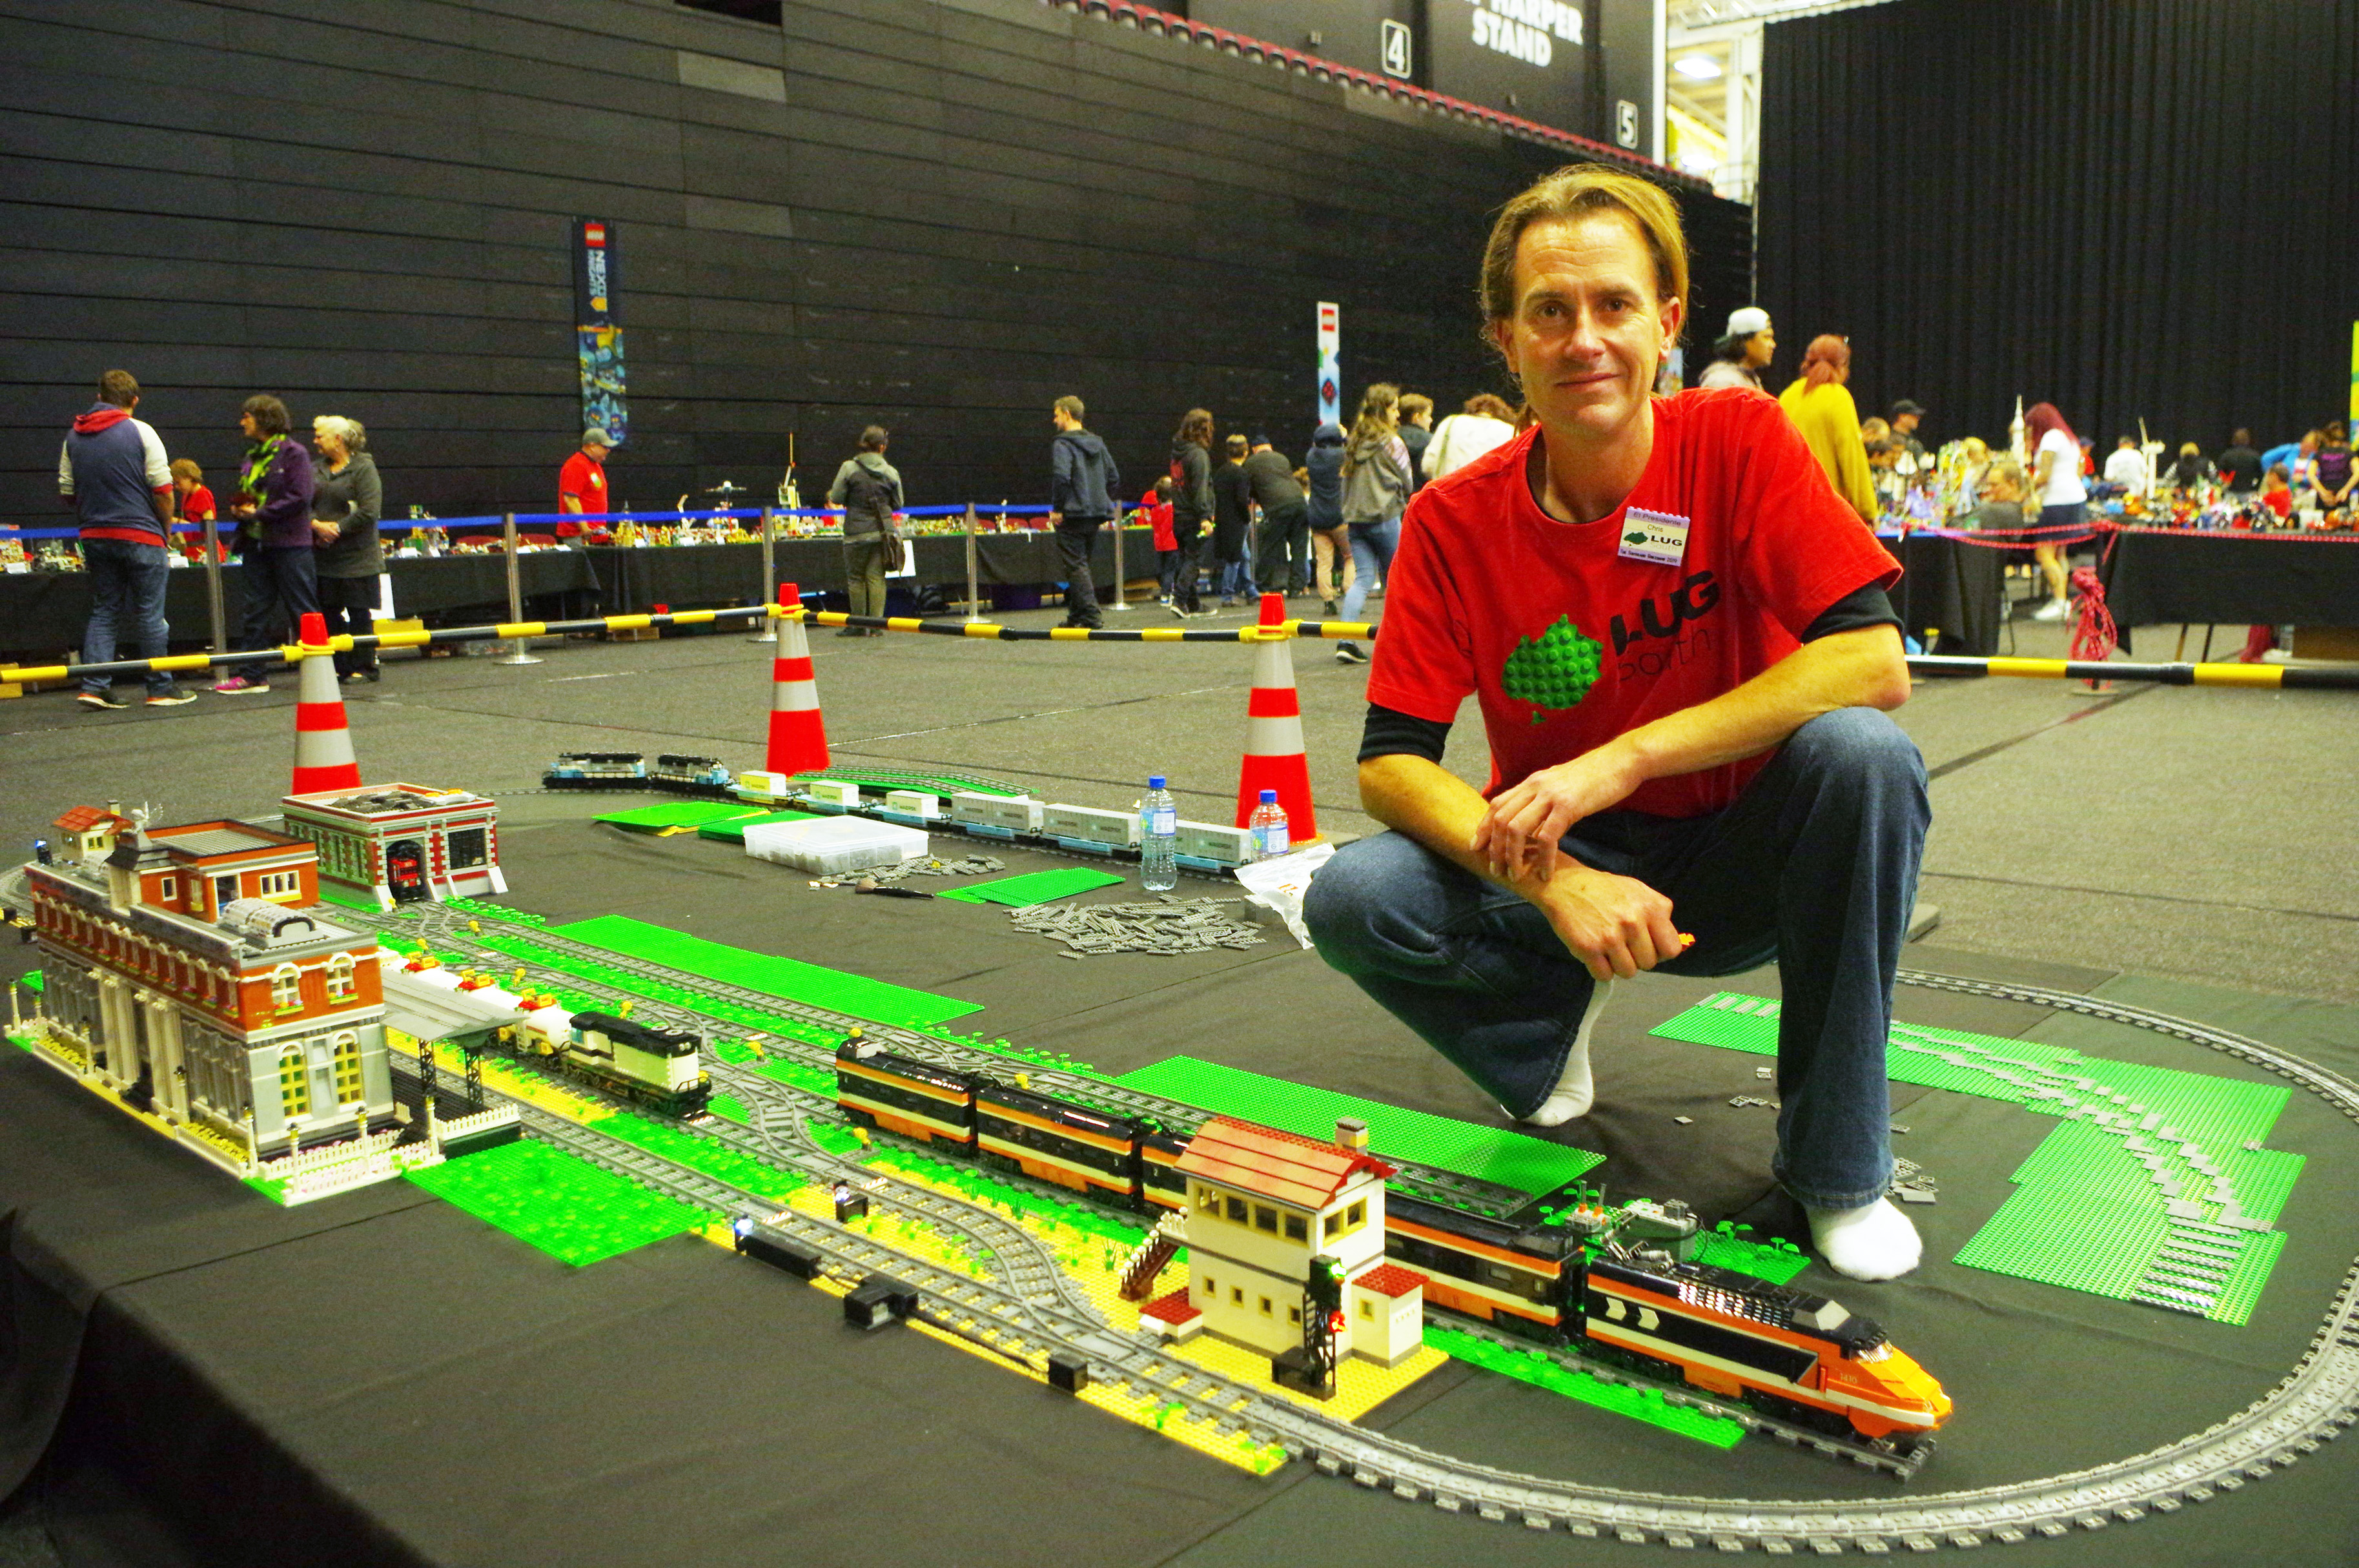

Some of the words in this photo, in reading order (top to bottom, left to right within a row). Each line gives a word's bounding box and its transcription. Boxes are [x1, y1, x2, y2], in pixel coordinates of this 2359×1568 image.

[1387, 29, 1405, 72] 4
[1472, 7, 1551, 67] STAND
[1622, 107, 1634, 143] 5
[595, 250, 606, 296] NEXO
[1642, 514, 1681, 525] Presidente
[1650, 535, 1682, 546] LUG
[1650, 542, 1677, 551] South
[1610, 571, 1719, 656] LUG
